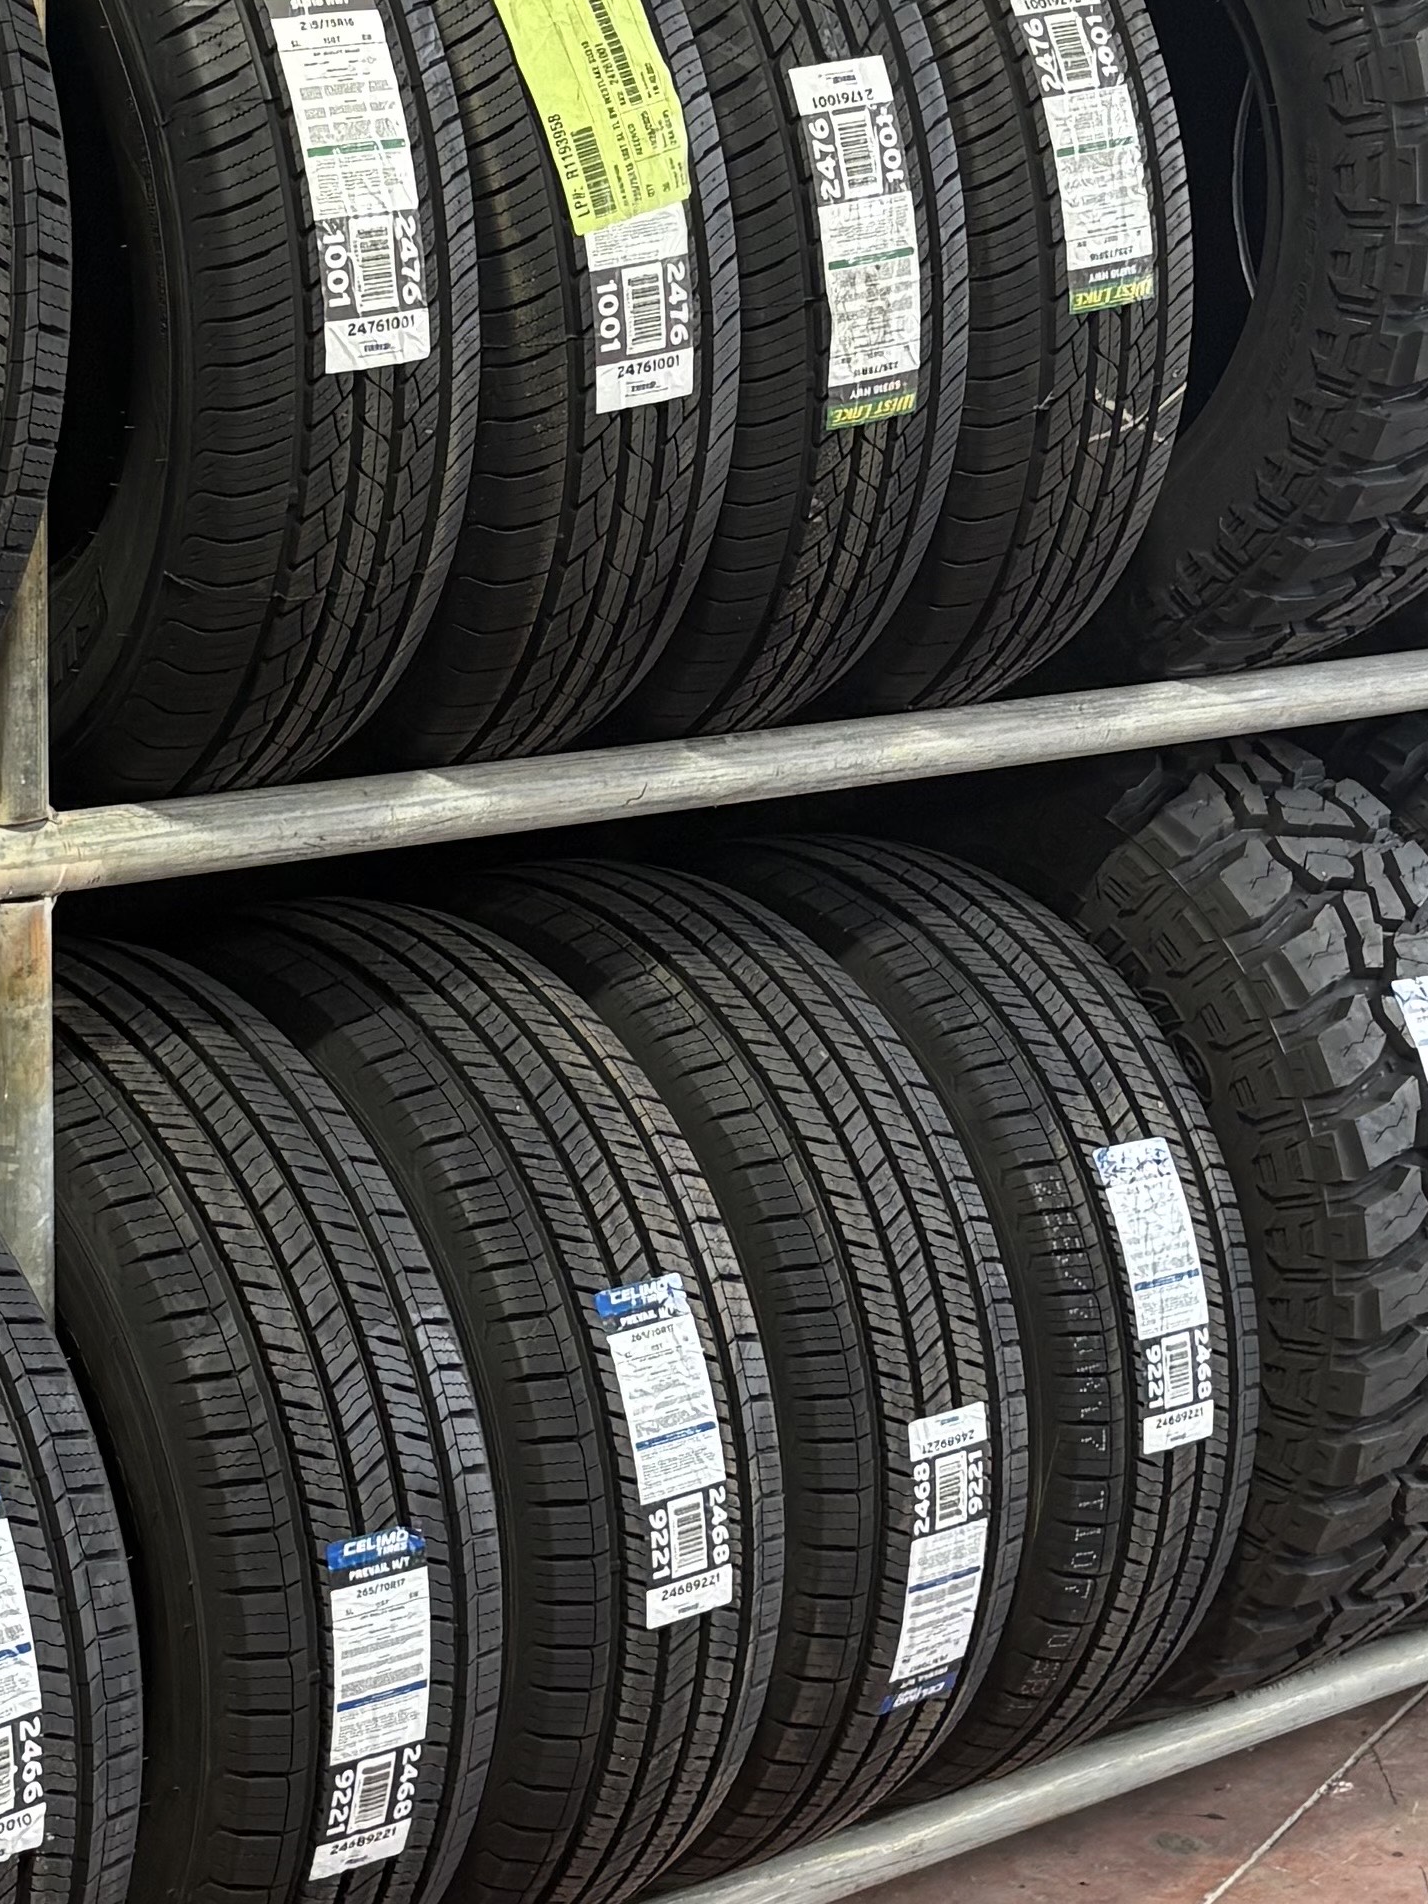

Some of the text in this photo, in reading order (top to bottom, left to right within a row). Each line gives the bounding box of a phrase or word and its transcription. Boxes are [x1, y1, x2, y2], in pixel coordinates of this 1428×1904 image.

[1024, 18, 1062, 93] 2476
[545, 112, 581, 180] R1193958
[810, 121, 841, 201] 2476
[324, 230, 352, 308] 1001
[396, 212, 420, 307] 2476
[347, 316, 416, 336] 24761001
[596, 279, 621, 353] 1001
[665, 261, 689, 347] 2476
[617, 354, 681, 379] 24761001
[831, 393, 915, 425] WEST LAKE
[1146, 1345, 1164, 1409] 9221
[1194, 1327, 1213, 1400] 2468
[913, 1461, 930, 1536] 2468
[968, 1450, 983, 1515] 9221
[344, 1530, 408, 1558] CELIMO
[648, 1509, 671, 1579] 9221
[708, 1486, 729, 1565] 2468
[348, 1564, 390, 1581] PREVAIL
[662, 1574, 720, 1601] 24689221
[19, 1717, 44, 1804] 2466
[393, 1744, 421, 1820] 2468
[326, 1769, 355, 1836] 9221
[330, 1827, 397, 1855] 24689221
